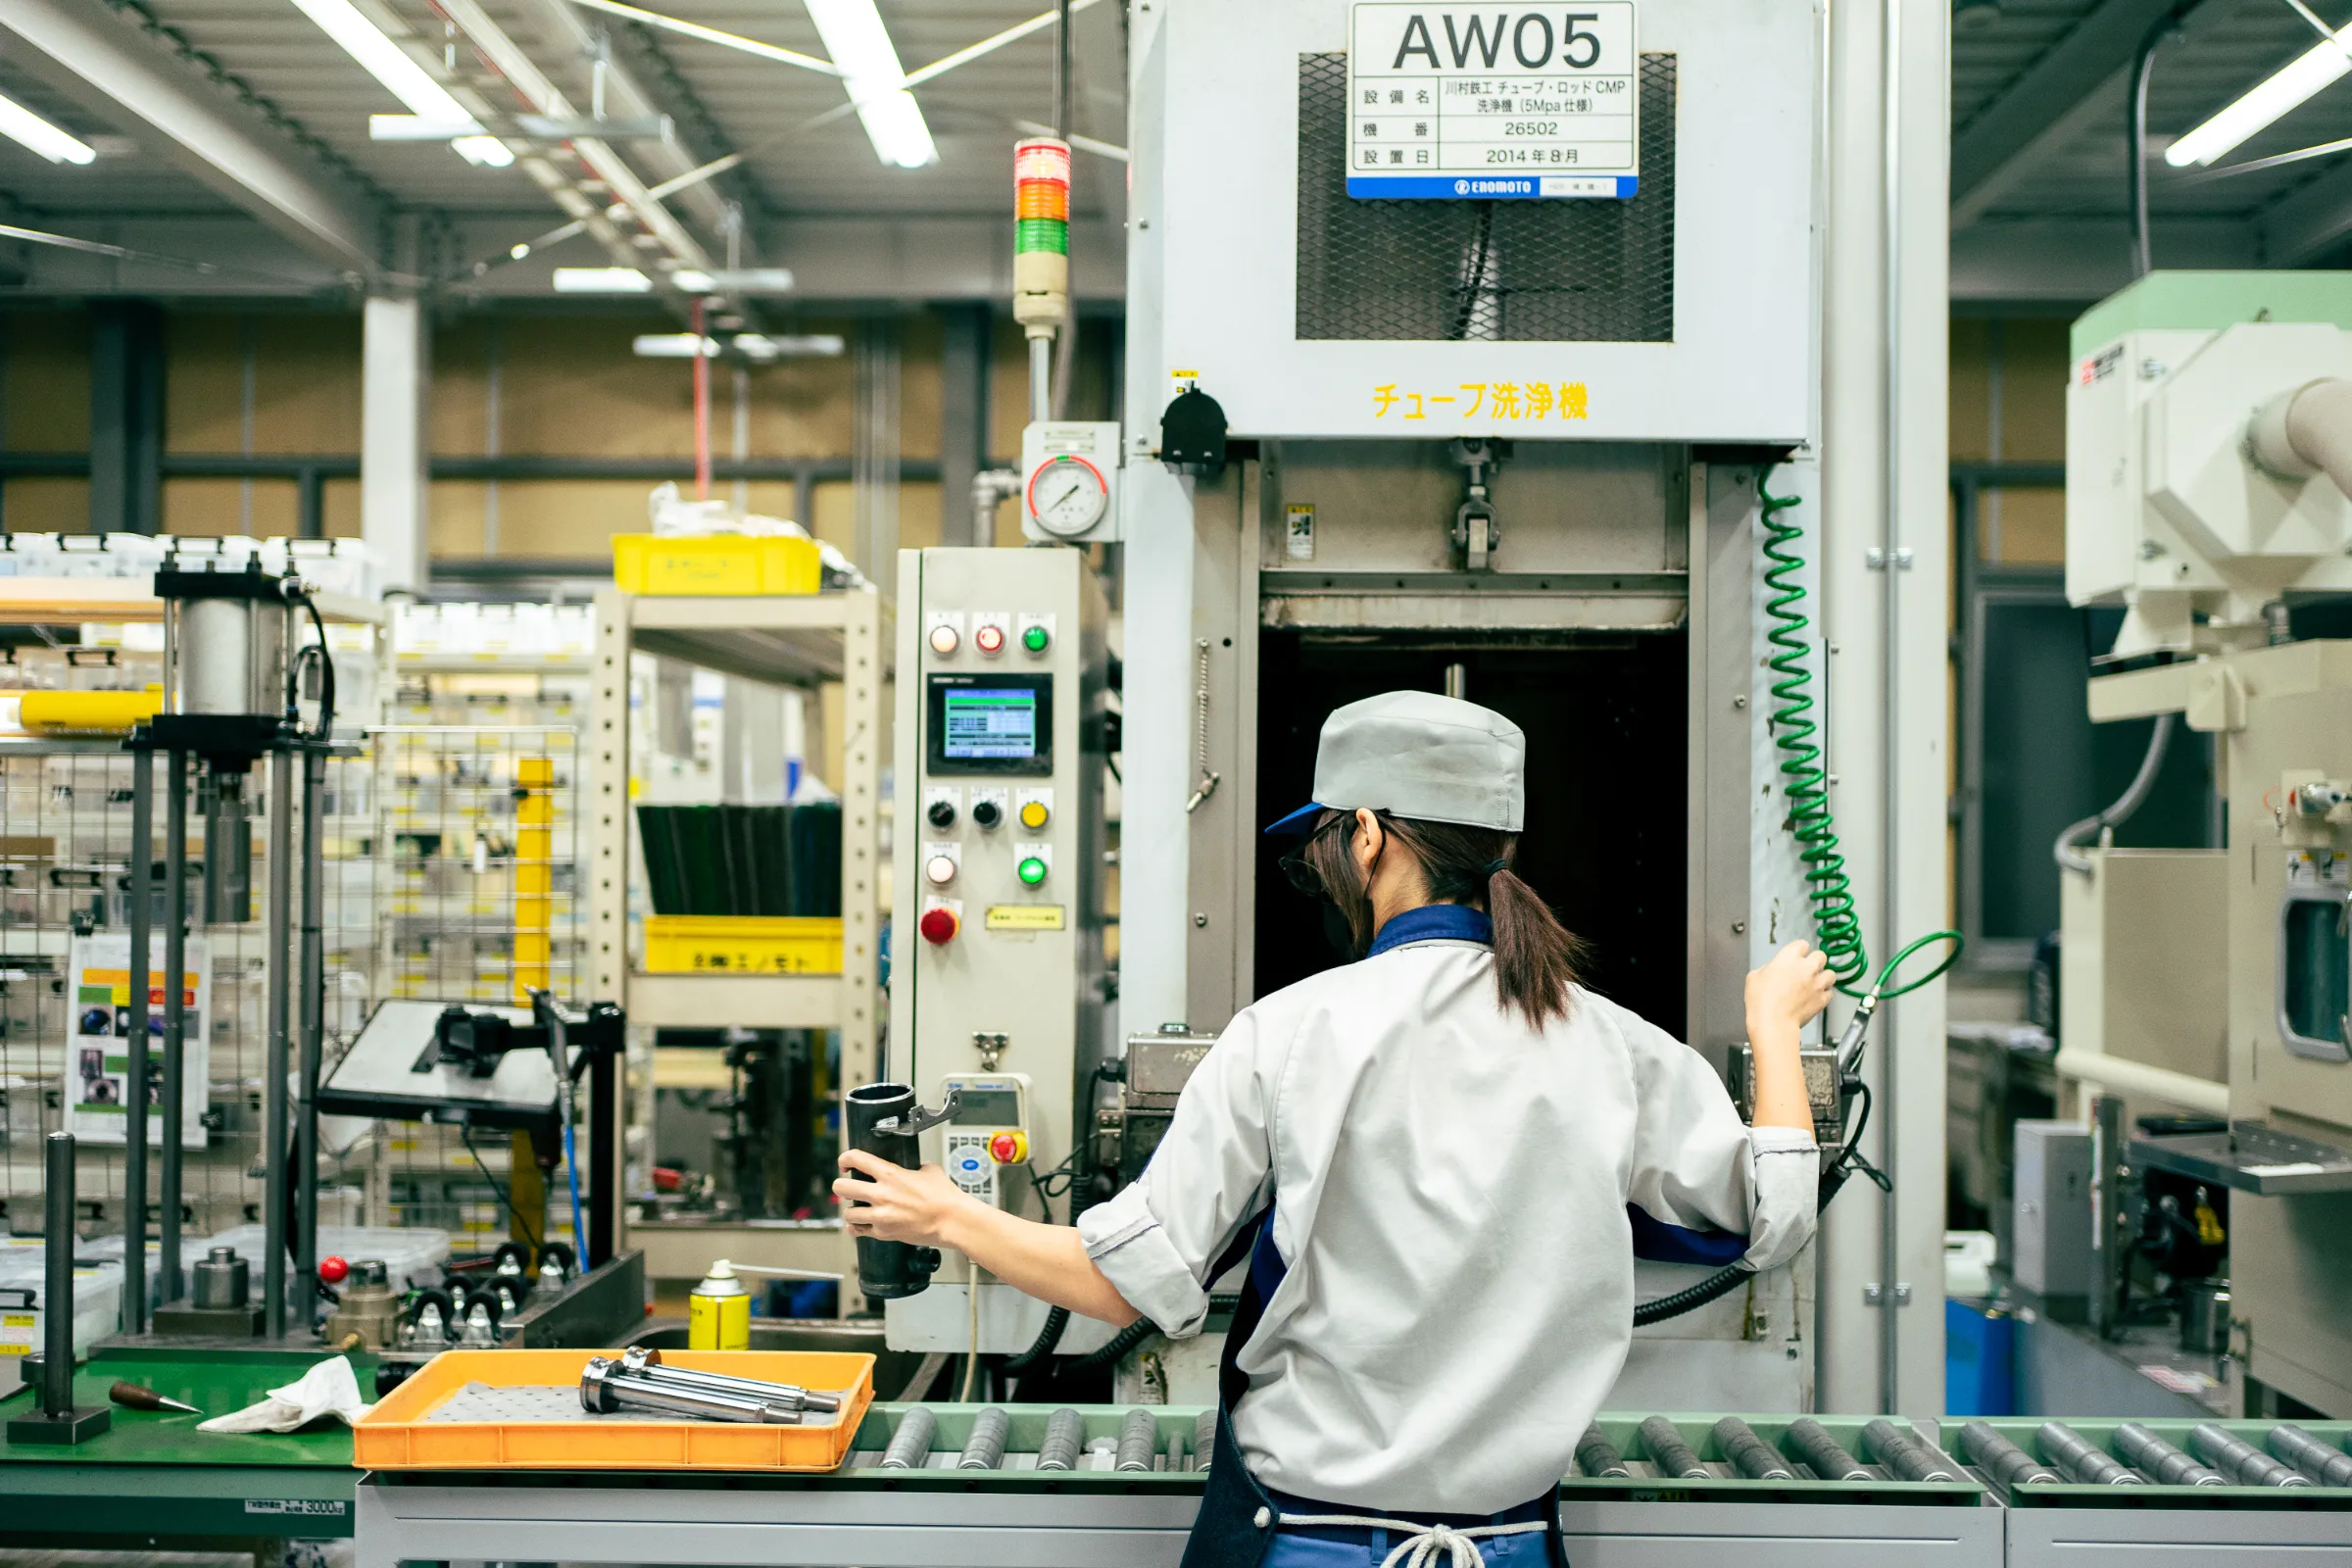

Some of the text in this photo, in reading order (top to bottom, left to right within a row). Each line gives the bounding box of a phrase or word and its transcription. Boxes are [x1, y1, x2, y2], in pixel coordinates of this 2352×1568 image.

[1392, 13, 1599, 69] AW05
[1504, 122, 1558, 136] 26502
[1471, 180, 1532, 194] ENOMOTO
